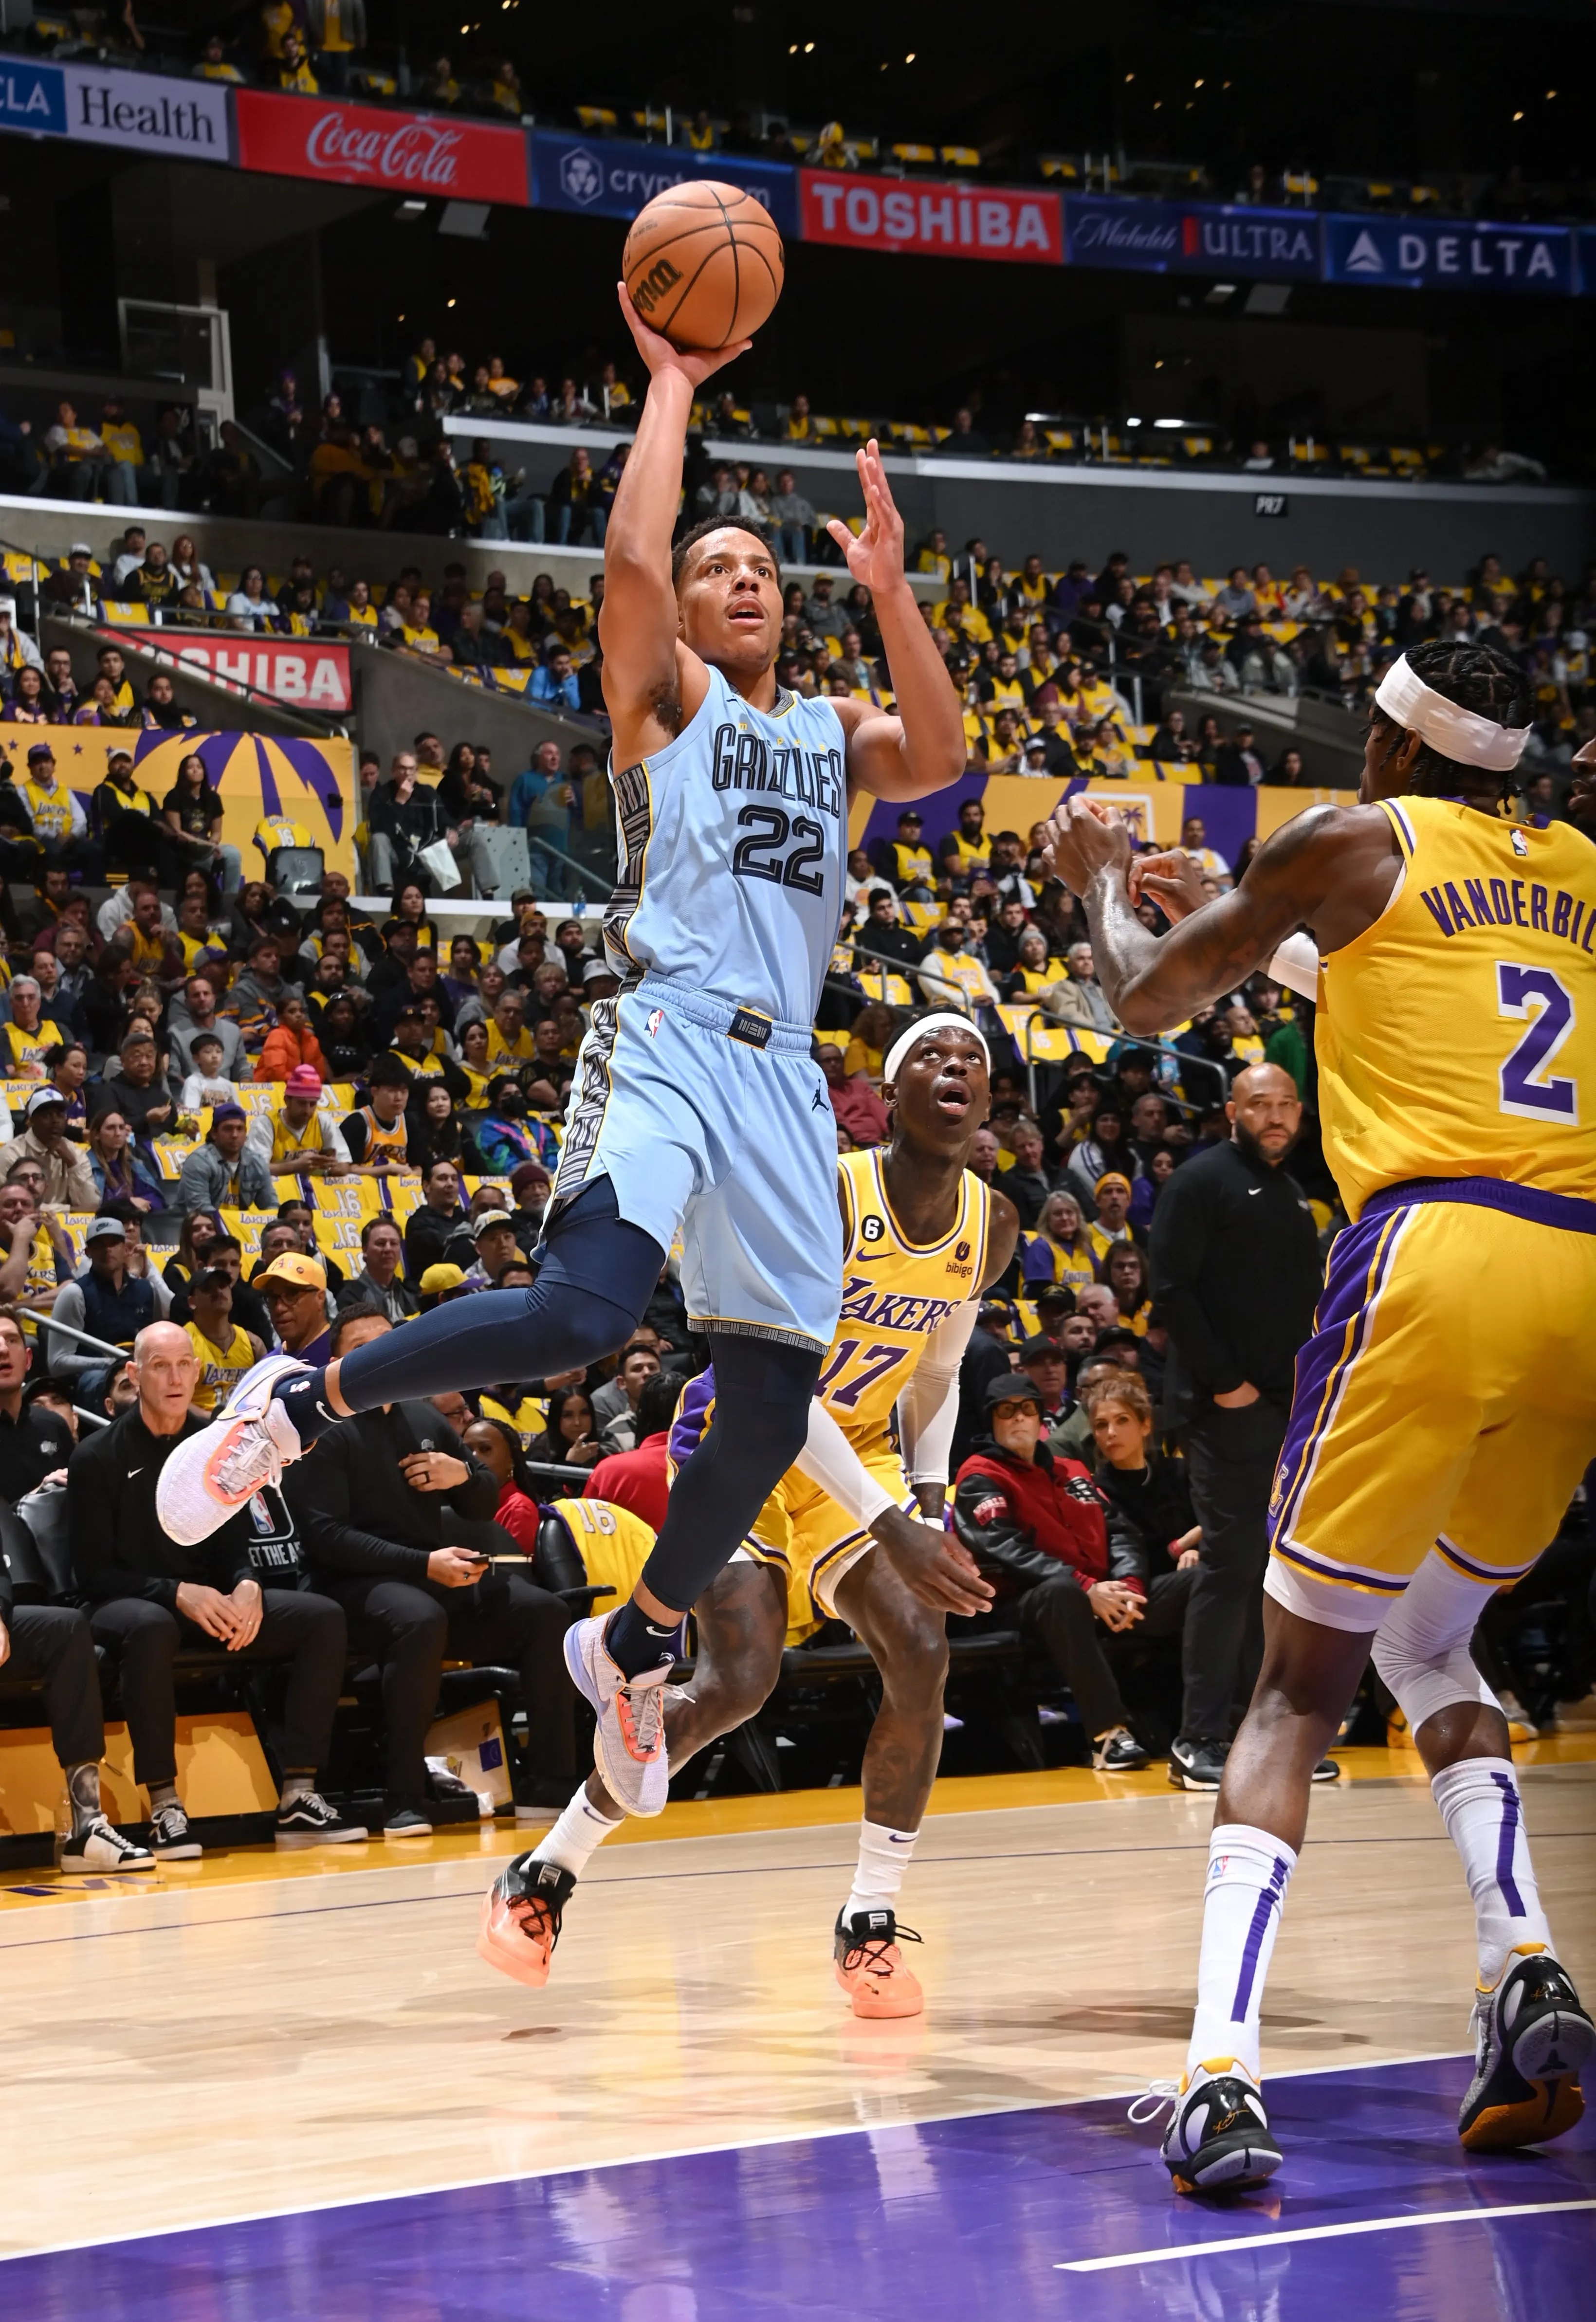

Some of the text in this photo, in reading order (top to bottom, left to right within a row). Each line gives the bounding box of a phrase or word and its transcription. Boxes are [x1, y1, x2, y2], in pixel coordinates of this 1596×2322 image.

[78, 84, 216, 144] Health
[307, 111, 465, 184] Coca-Cola
[812, 183, 1050, 250] TOSHIBA
[1203, 222, 1313, 260] ULTRA
[1398, 235, 1556, 279] DELTA
[712, 723, 842, 819] GRIZZLIES
[733, 804, 824, 897] 22
[1420, 878, 1596, 956] VANDERBIL
[1494, 959, 1580, 1127] 2
[324, 1175, 363, 1186] LAKERS
[334, 1189, 362, 1211] 16
[323, 1209, 362, 1218] LAKERS
[334, 1222, 362, 1246] 16
[864, 1218, 880, 1240] 6
[946, 1262, 972, 1279] bibigo
[839, 1275, 964, 1337] LAKERS
[814, 1338, 912, 1415] 17
[567, 1498, 617, 1536] 16
[248, 1546, 263, 1567] ET
[261, 1543, 290, 1566] THE
